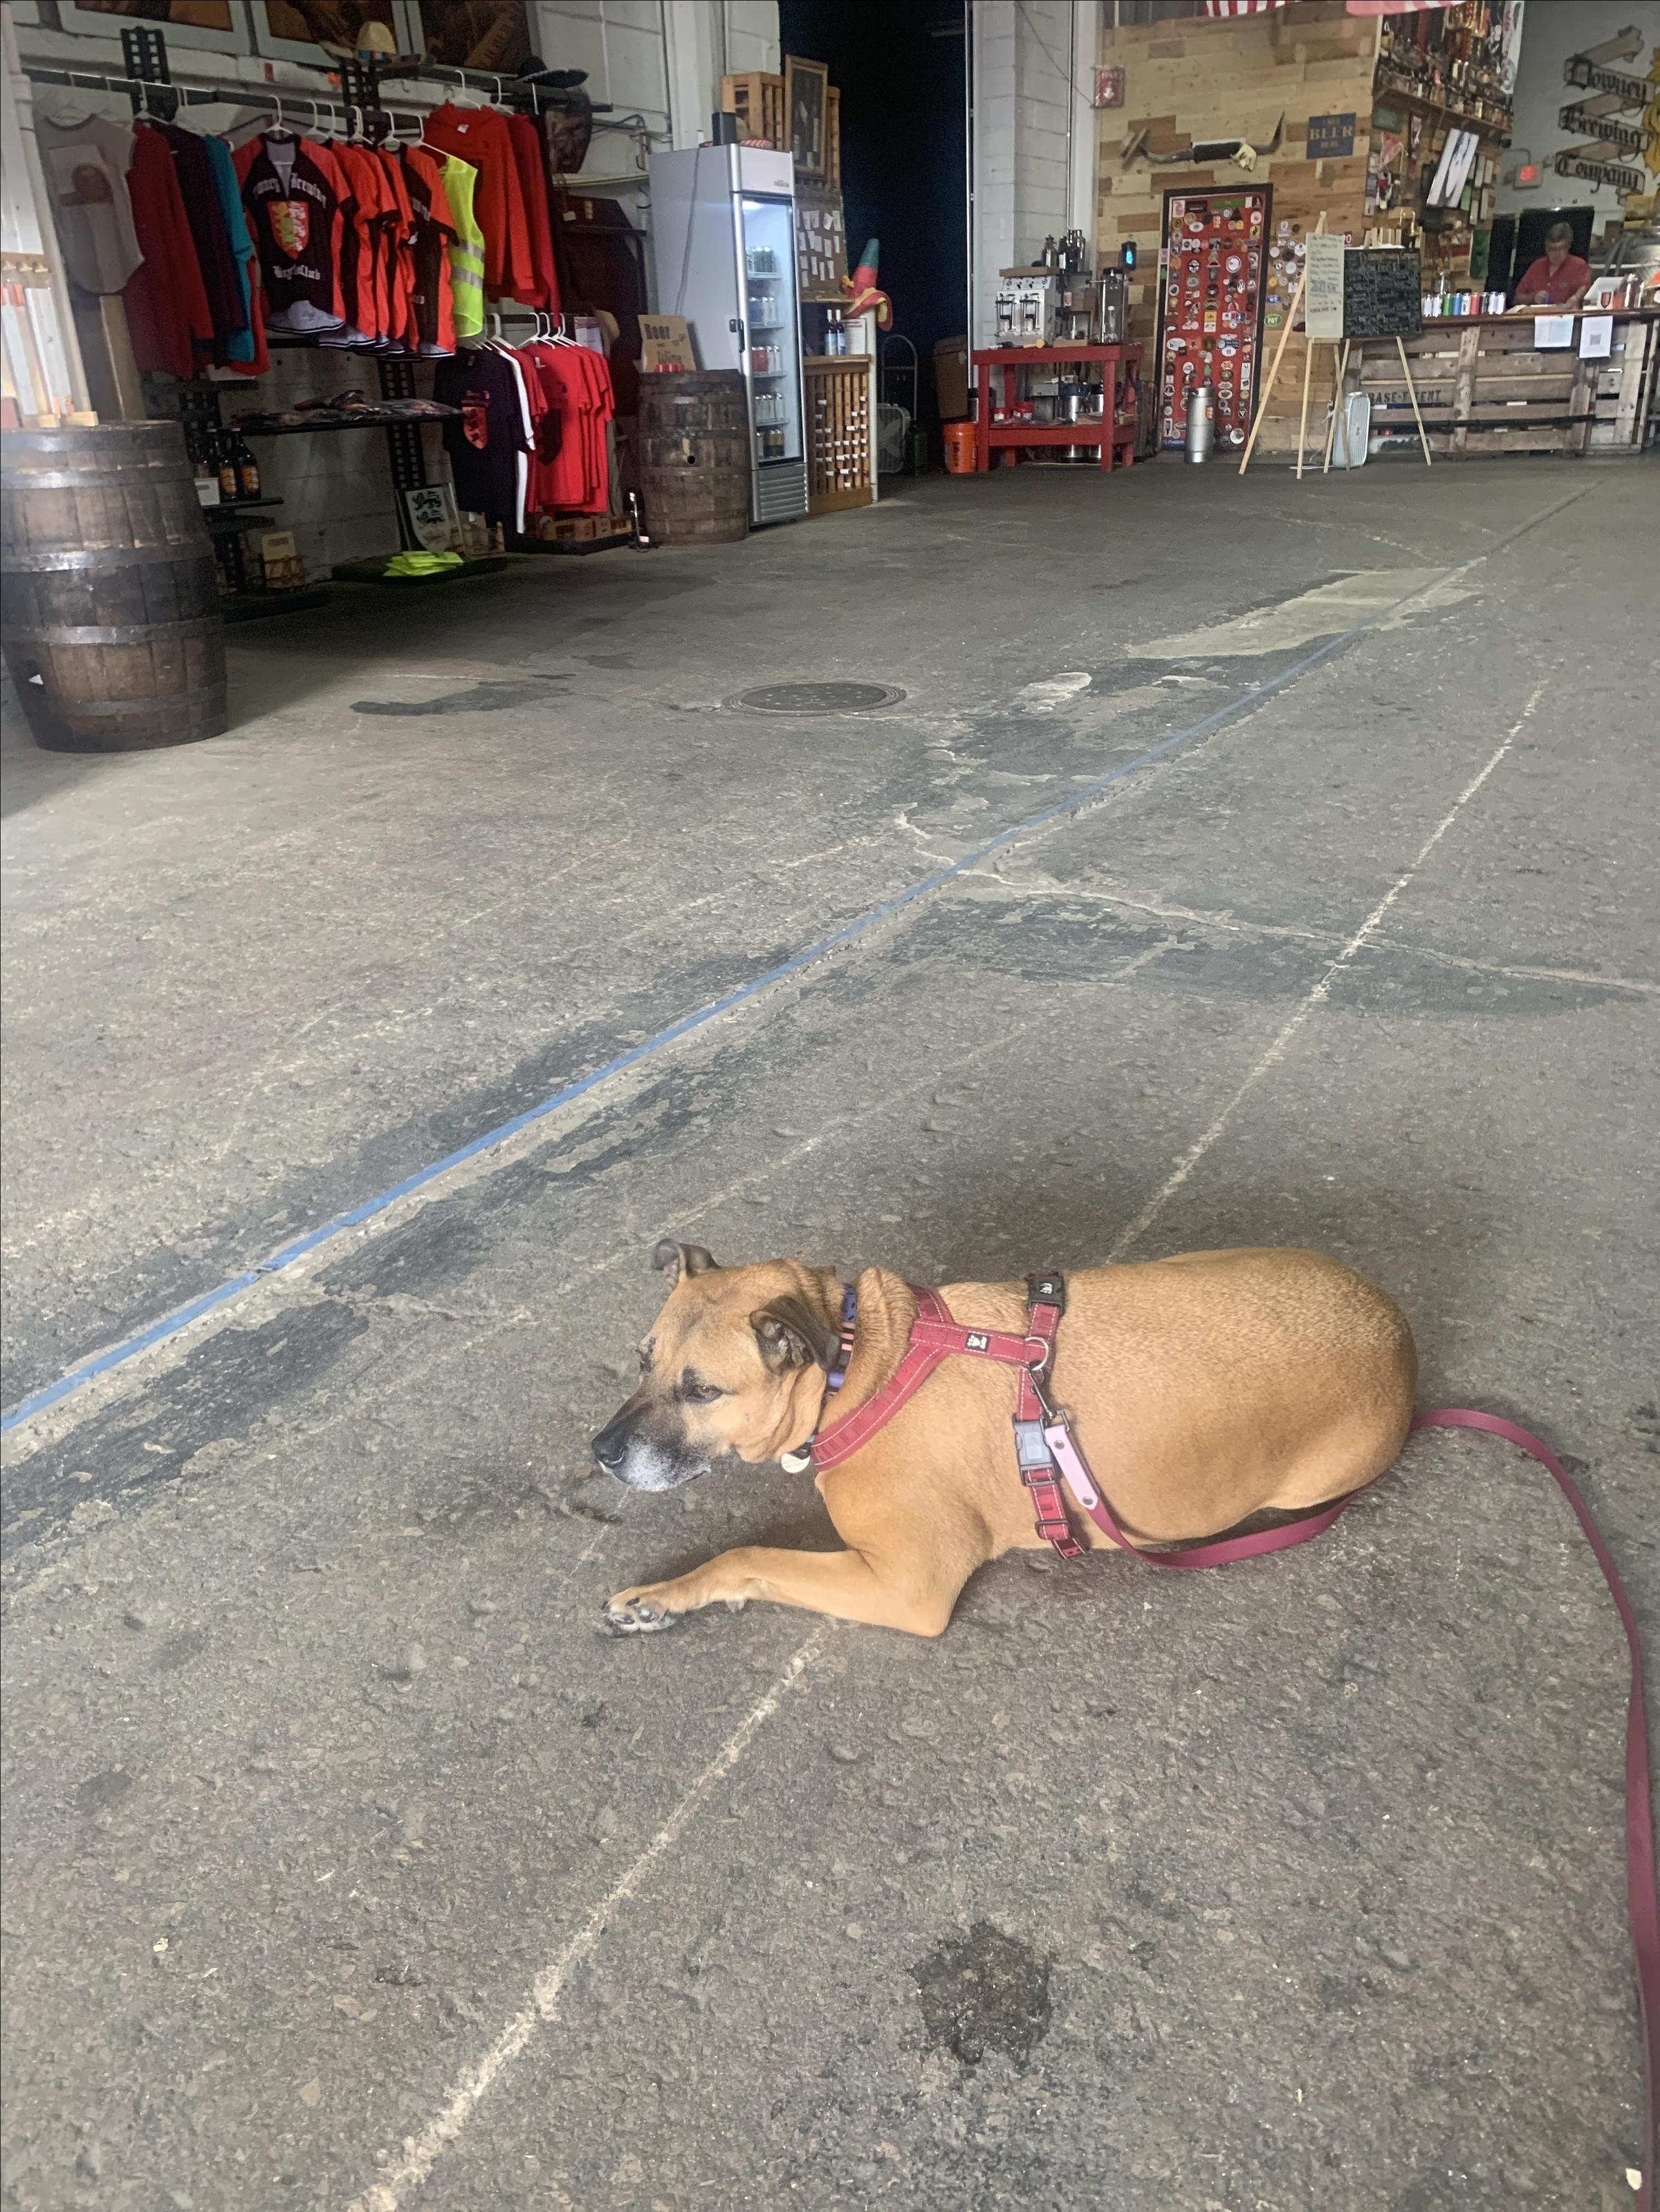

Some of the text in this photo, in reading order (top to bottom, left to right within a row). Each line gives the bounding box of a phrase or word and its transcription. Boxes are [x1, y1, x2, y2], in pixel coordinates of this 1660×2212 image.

[1565, 53, 1647, 116] Downey
[1310, 126, 1353, 140] BEER
[1560, 105, 1643, 162] Brewing
[1557, 156, 1639, 193] Company
